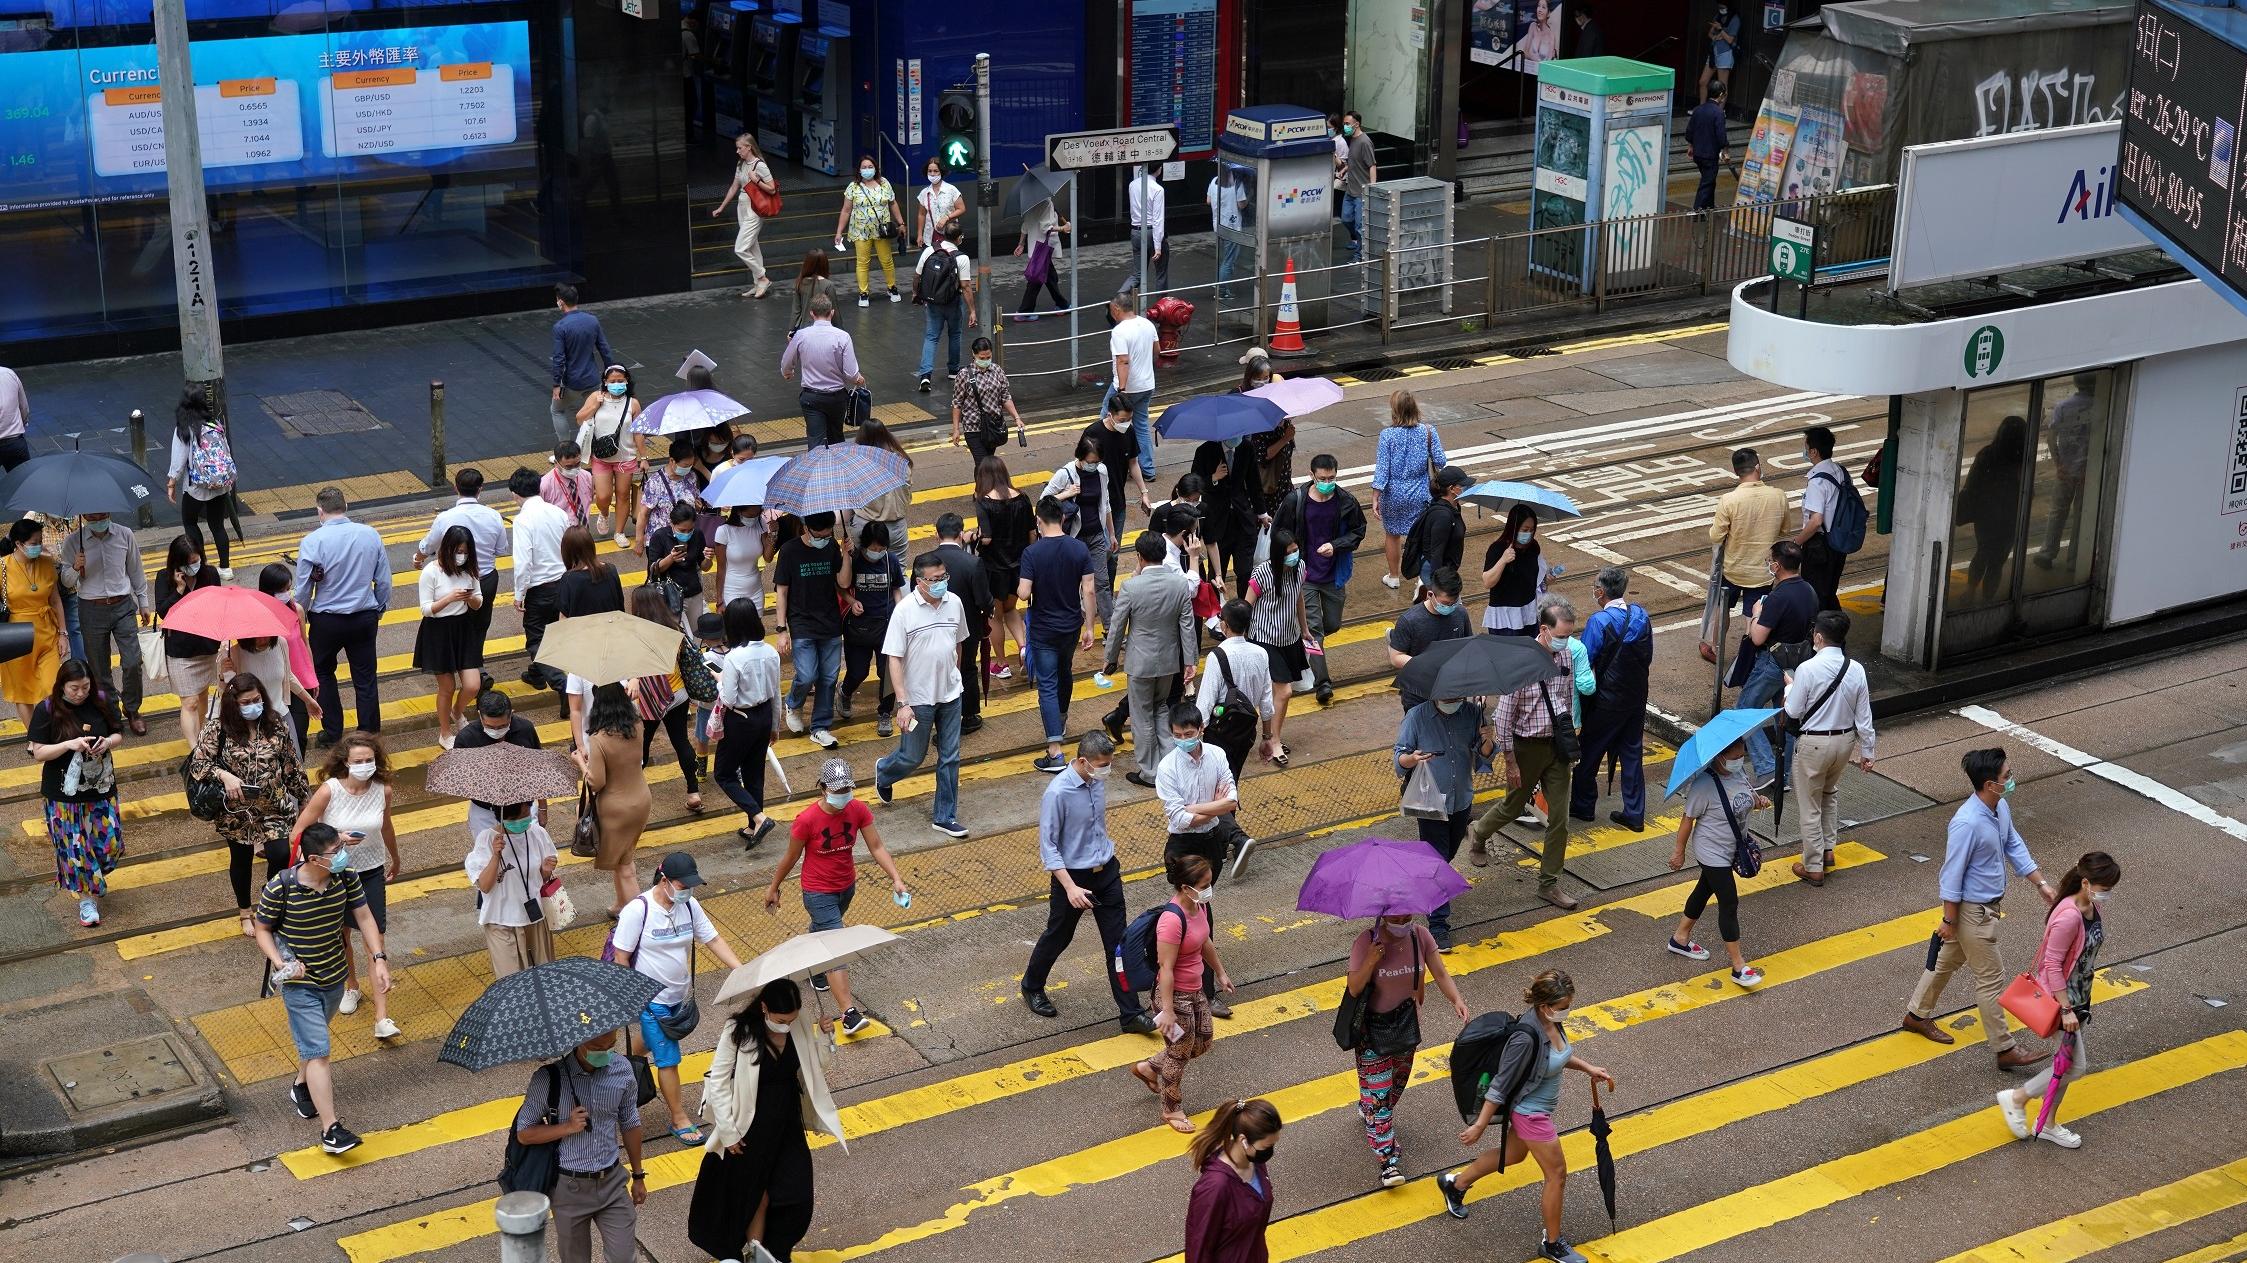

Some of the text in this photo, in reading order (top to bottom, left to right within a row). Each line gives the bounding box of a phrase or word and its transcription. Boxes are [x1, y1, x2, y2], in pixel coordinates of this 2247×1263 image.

[318, 46, 419, 69] 主要外幣匯率
[458, 68, 478, 77] Price
[355, 75, 390, 85] Currency
[240, 83, 260, 92] Price
[354, 86, 484, 103] GBP/USD 1.2203
[1634, 94, 1664, 104] PAYPHONE
[239, 102, 268, 112] 0.6565
[356, 102, 486, 118] USD/HKD 7.7502
[5, 106, 49, 120] 369.04
[242, 118, 269, 127] 1.3934
[356, 117, 486, 134] USD/JPY 107.61
[2153, 94, 2190, 147] 26-29
[1234, 122, 1247, 130] PCCW
[244, 134, 270, 143] 7.1044
[358, 132, 487, 150] NZD/USD 0.6123
[1064, 134, 1167, 150] Des Voeux Road Central
[245, 150, 272, 159] 1.0962
[10, 154, 35, 166] 1.46
[1554, 176, 1568, 186] HGC
[1301, 188, 1323, 198] PCCW
[2166, 172, 2204, 230] 80-95
[1800, 246, 1810, 254] 27E
